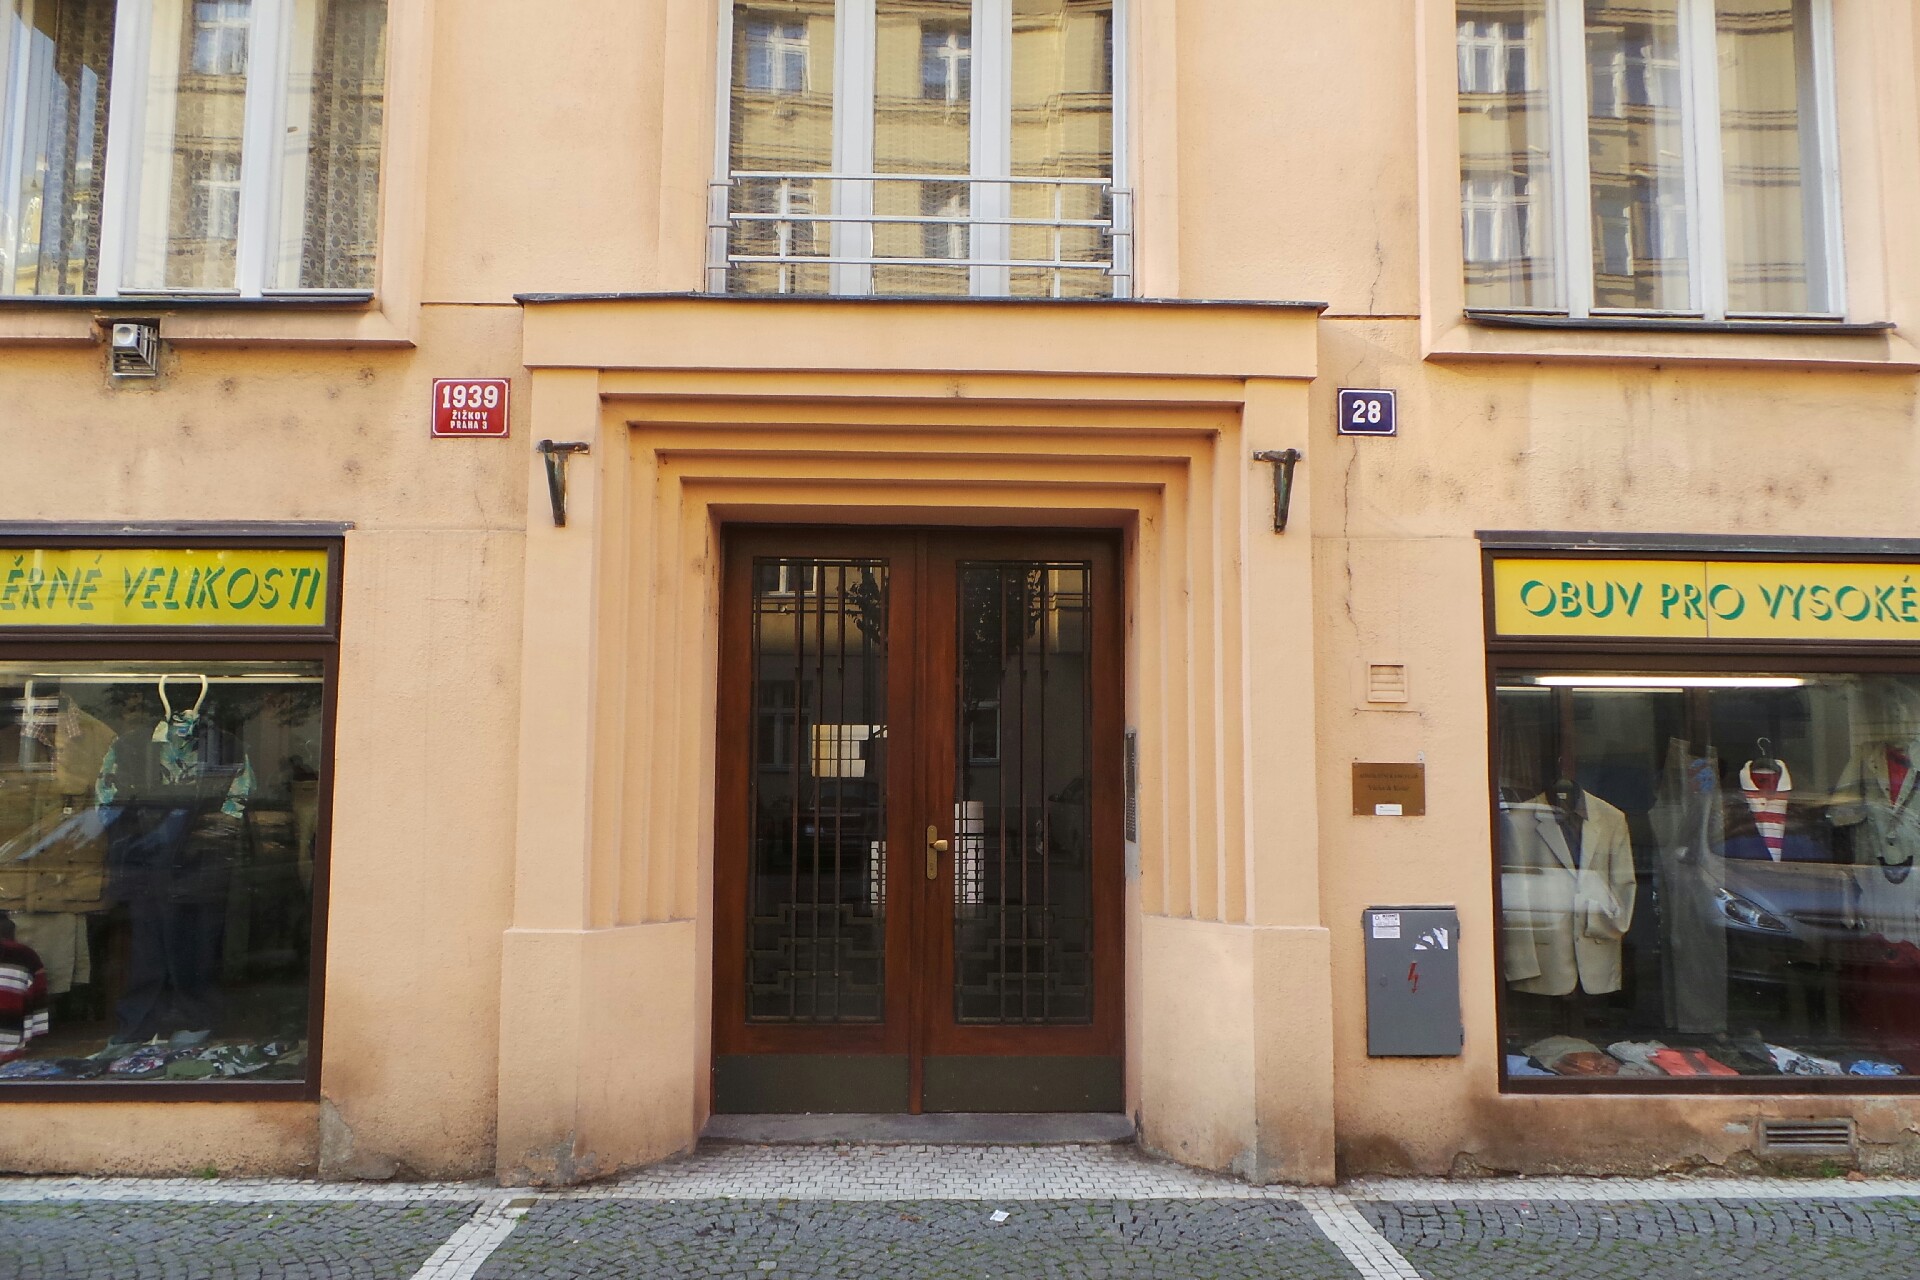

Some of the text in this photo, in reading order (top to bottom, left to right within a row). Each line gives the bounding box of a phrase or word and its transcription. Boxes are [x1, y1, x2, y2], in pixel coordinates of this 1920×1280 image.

[442, 385, 499, 409] 1939
[451, 409, 488, 420] ŽIŽKOV
[1352, 399, 1381, 424] 28
[450, 420, 488, 430] PRAHA 3
[0, 554, 322, 611] ĚRNÉ VELIKOSTI
[1519, 574, 1919, 623] OBUV PRO VYSOKÉ
